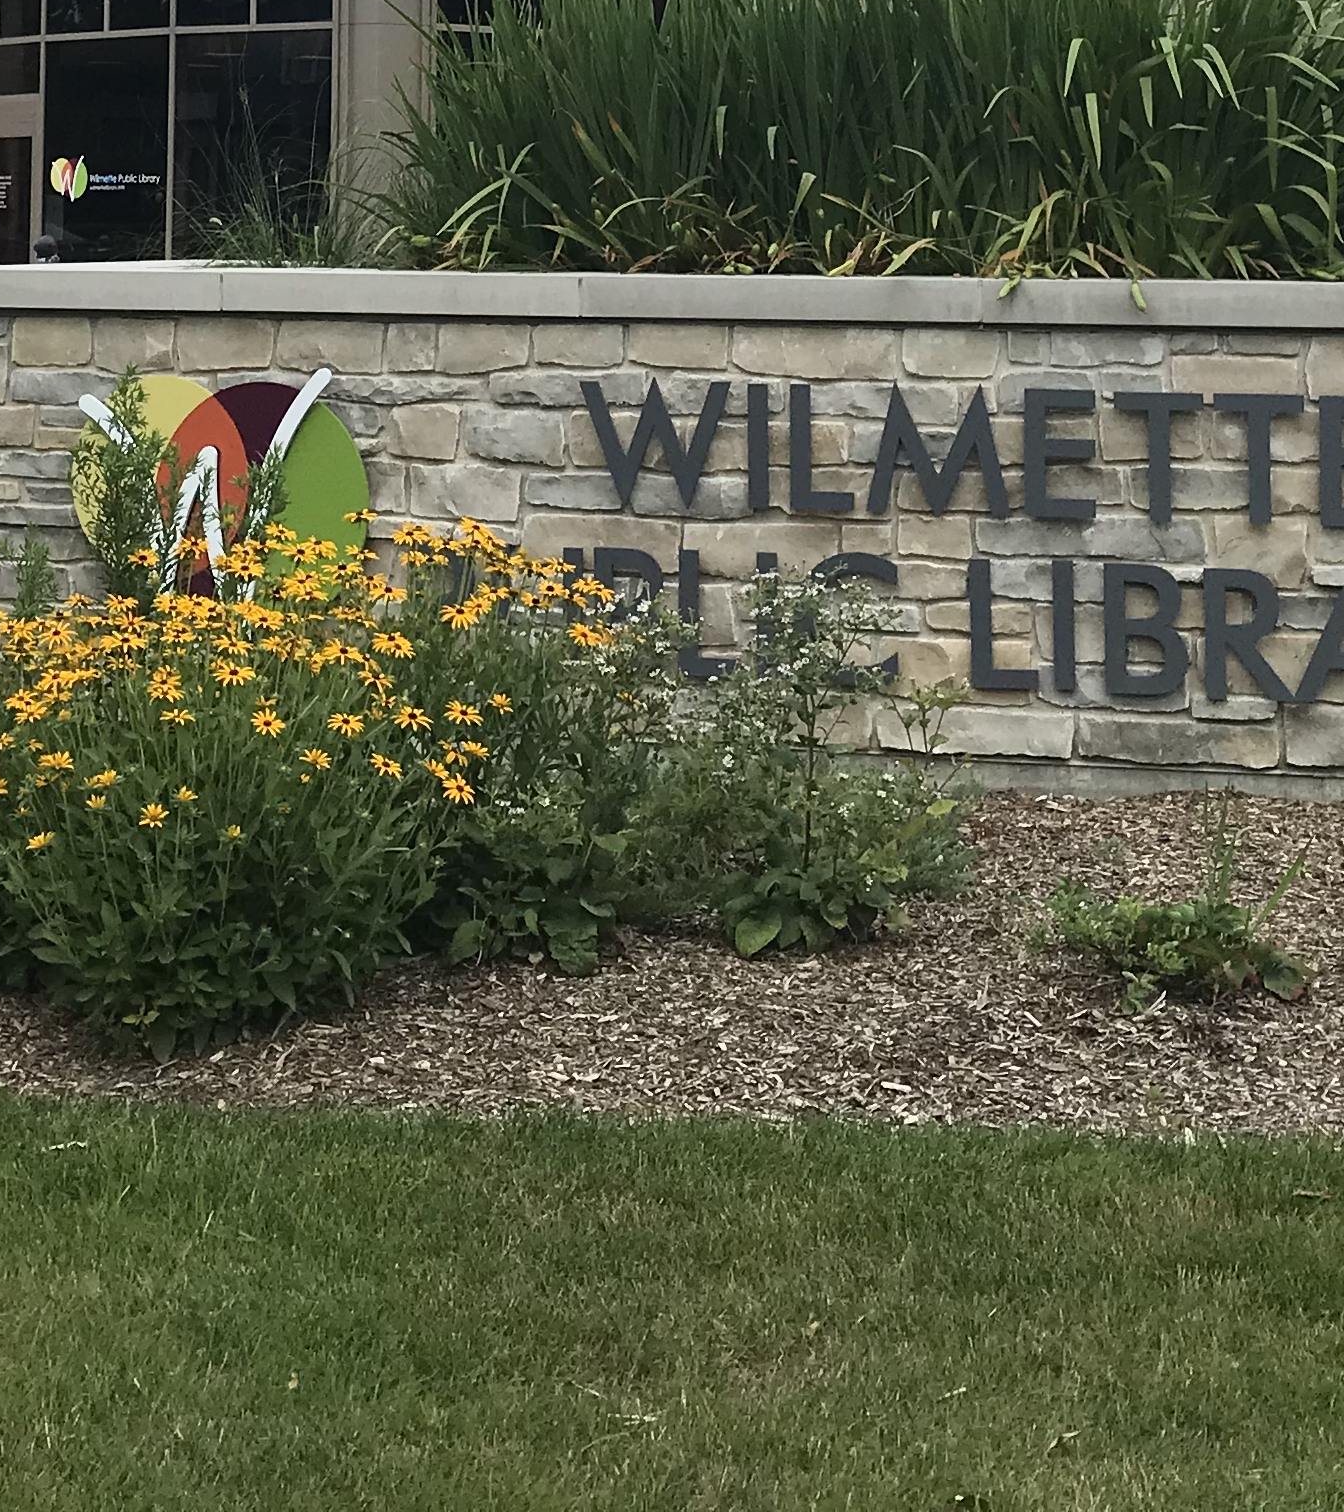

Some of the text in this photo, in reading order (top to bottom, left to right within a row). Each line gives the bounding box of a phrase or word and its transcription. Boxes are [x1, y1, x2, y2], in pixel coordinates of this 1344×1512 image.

[118, 173, 137, 183] Public
[138, 173, 160, 185] Library
[410, 542, 900, 690] BLIC
